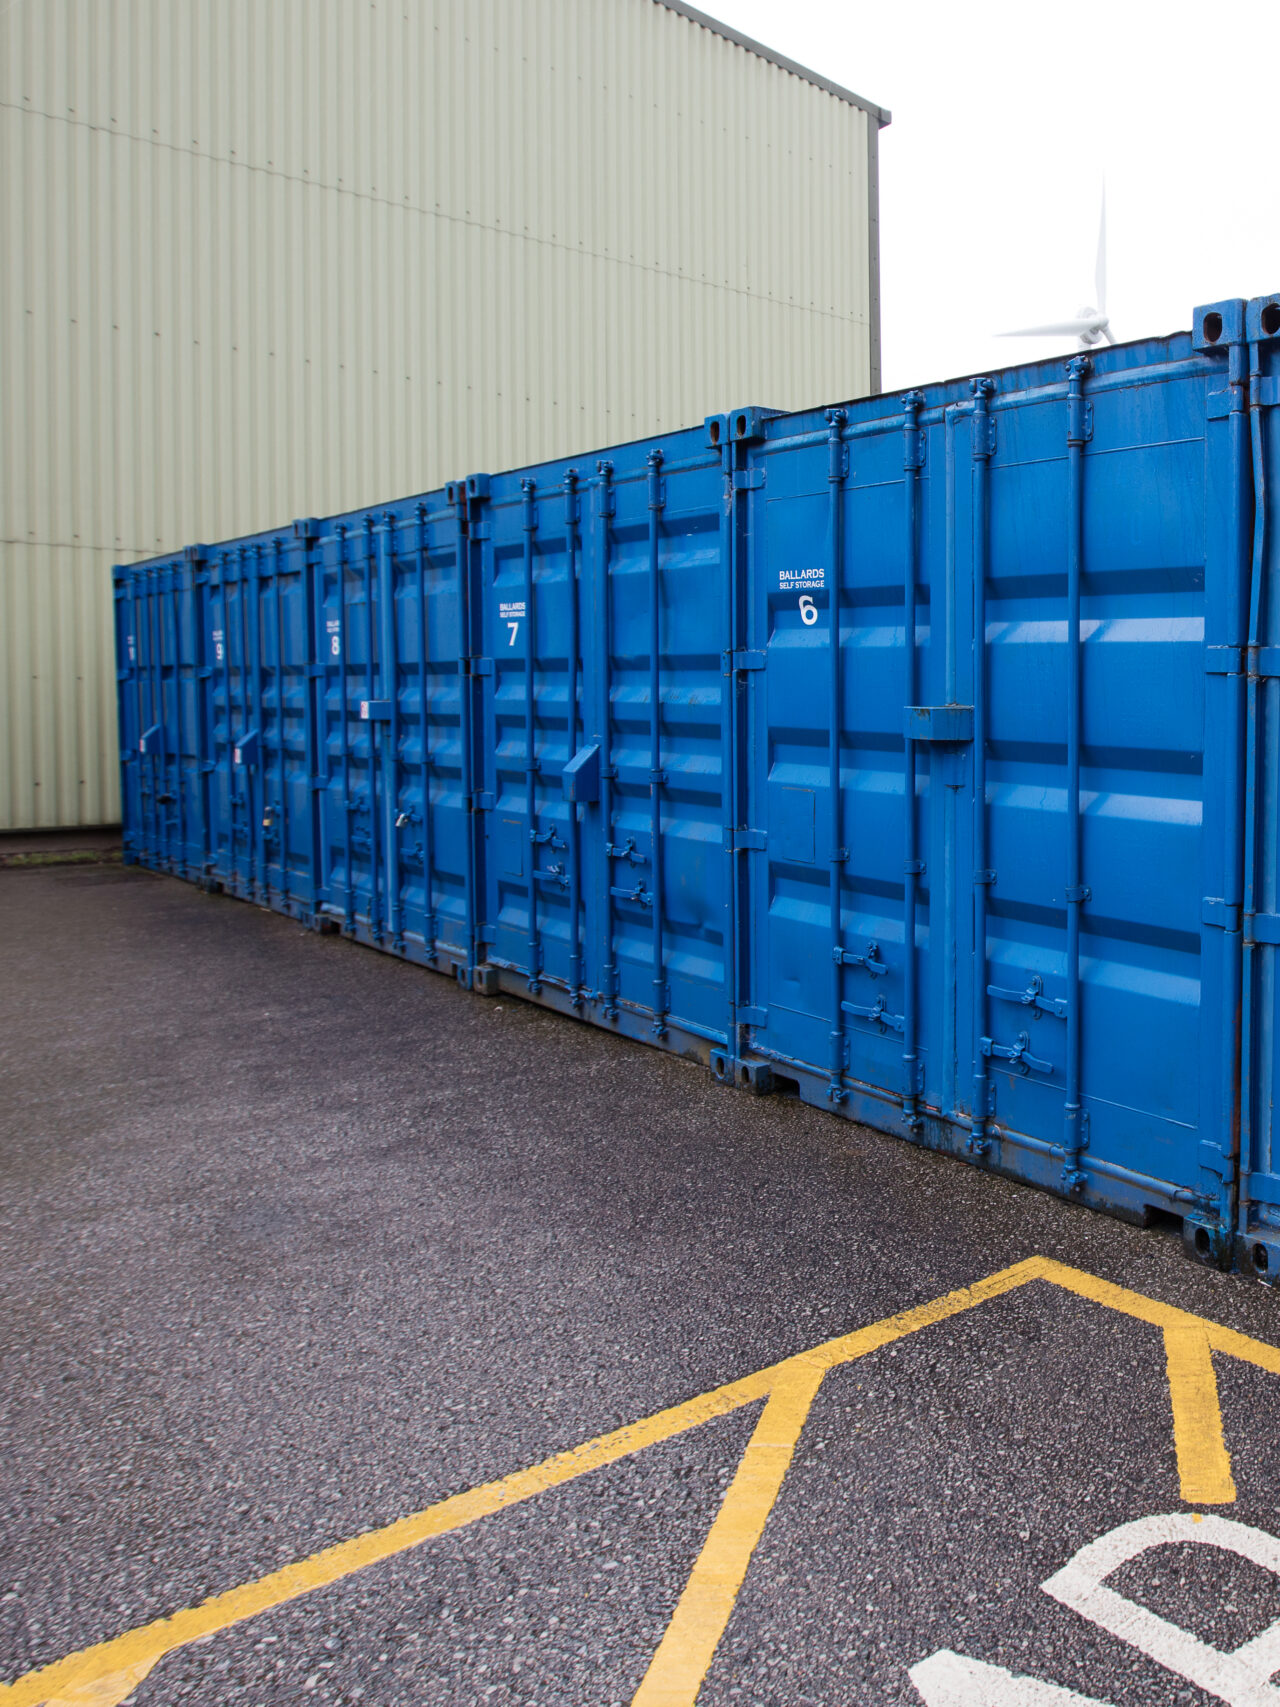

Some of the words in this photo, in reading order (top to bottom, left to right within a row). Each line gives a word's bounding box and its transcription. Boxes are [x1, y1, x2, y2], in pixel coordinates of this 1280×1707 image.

[779, 568, 825, 581] BALLARDS
[779, 581, 795, 590] SELF
[795, 580, 825, 589] STORAGE
[798, 595, 818, 626] 6
[507, 622, 519, 646] 7
[216, 644, 223, 660] 9
[331, 635, 340, 656] 8
